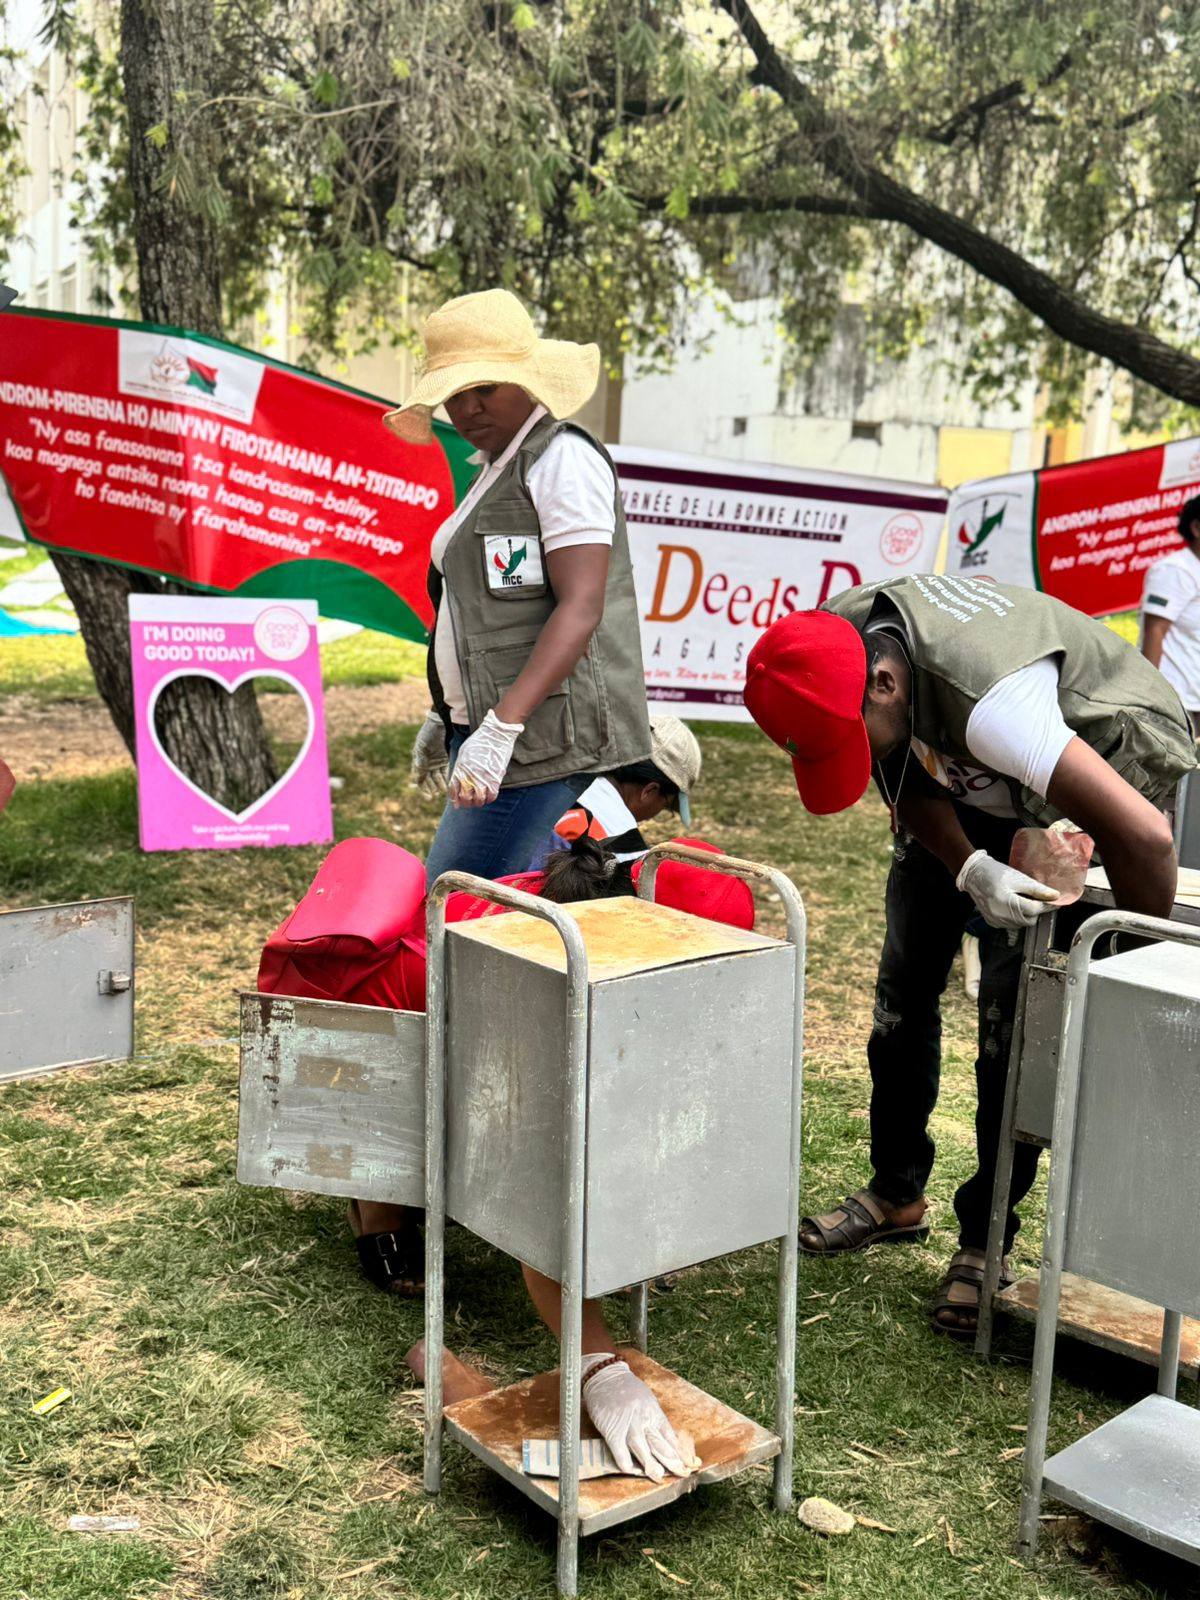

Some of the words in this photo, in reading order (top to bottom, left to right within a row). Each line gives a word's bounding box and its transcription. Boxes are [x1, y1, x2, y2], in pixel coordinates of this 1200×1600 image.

[64, 429, 91, 446] asa
[95, 430, 185, 467] fanasoavana
[192, 454, 225, 477] tsa
[127, 403, 148, 427] HO
[221, 425, 333, 480] FIROTSAHANA
[333, 461, 440, 510] AN-TSITRAPO
[5, 439, 33, 461] koa
[37, 449, 102, 478] magnega
[107, 462, 159, 488] antsika
[215, 484, 264, 516] hanao
[268, 506, 300, 526] asa
[303, 516, 404, 556] an-tsitrapo
[75, 477, 95, 499] ho
[99, 484, 165, 516] fanohitsa
[168, 504, 187, 525] ny
[680, 496, 700, 515] DE
[707, 499, 725, 517] LA
[734, 503, 786, 525] BONNE
[791, 508, 849, 532] ACTION
[1161, 490, 1182, 509] HO
[644, 544, 799, 629] Deeds
[143, 625, 169, 642] I'M
[171, 626, 226, 642] DOING
[144, 645, 193, 662] GOOD
[196, 646, 256, 662] TODAY!
